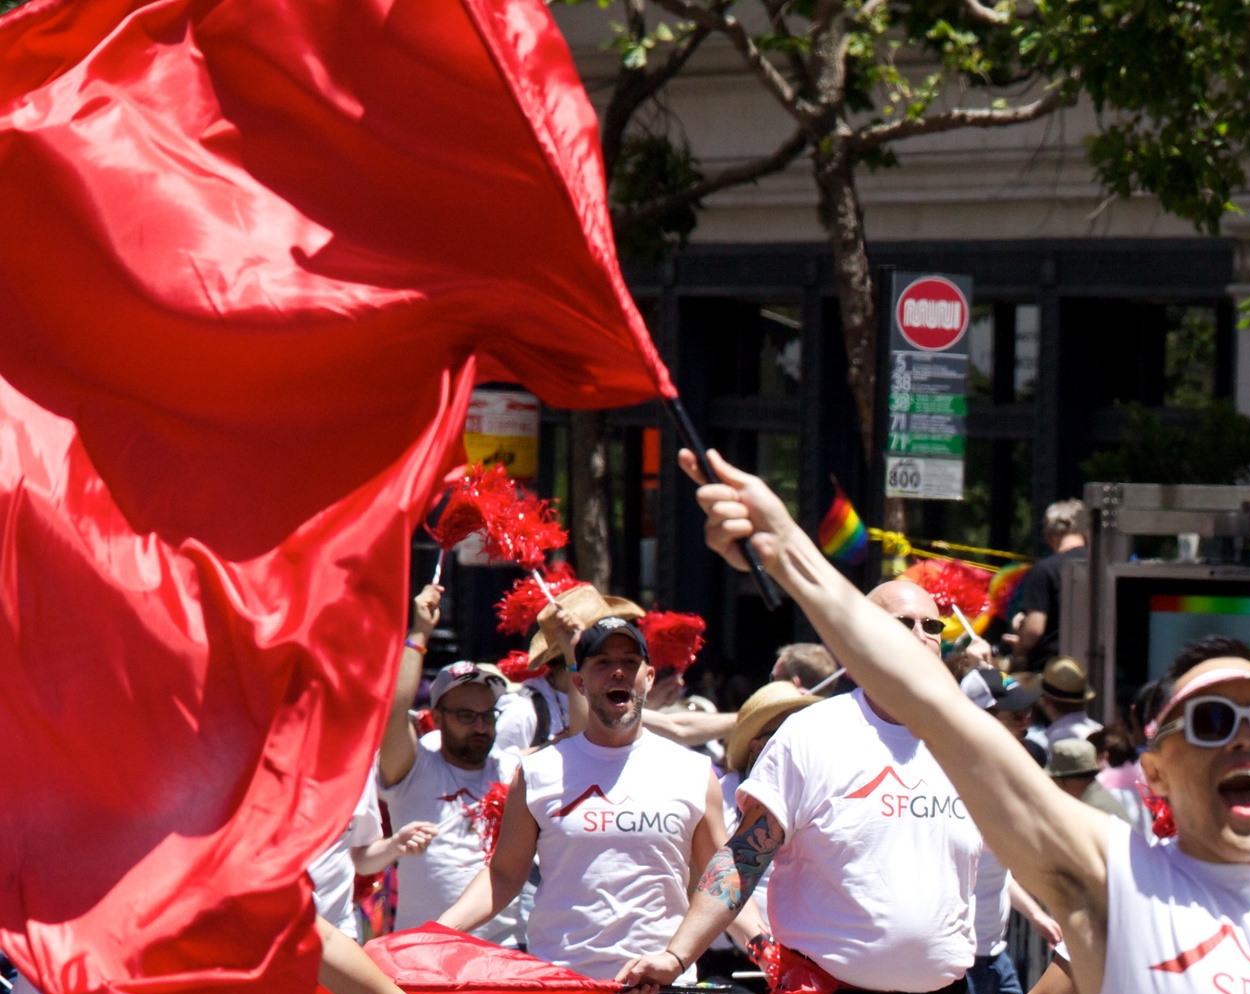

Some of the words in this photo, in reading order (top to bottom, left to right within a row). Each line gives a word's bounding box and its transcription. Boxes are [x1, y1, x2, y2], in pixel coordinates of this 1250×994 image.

[892, 373, 911, 392] 38
[890, 414, 907, 431] 71
[881, 794, 965, 819] SFGMC
[583, 811, 680, 834] SFGMC
